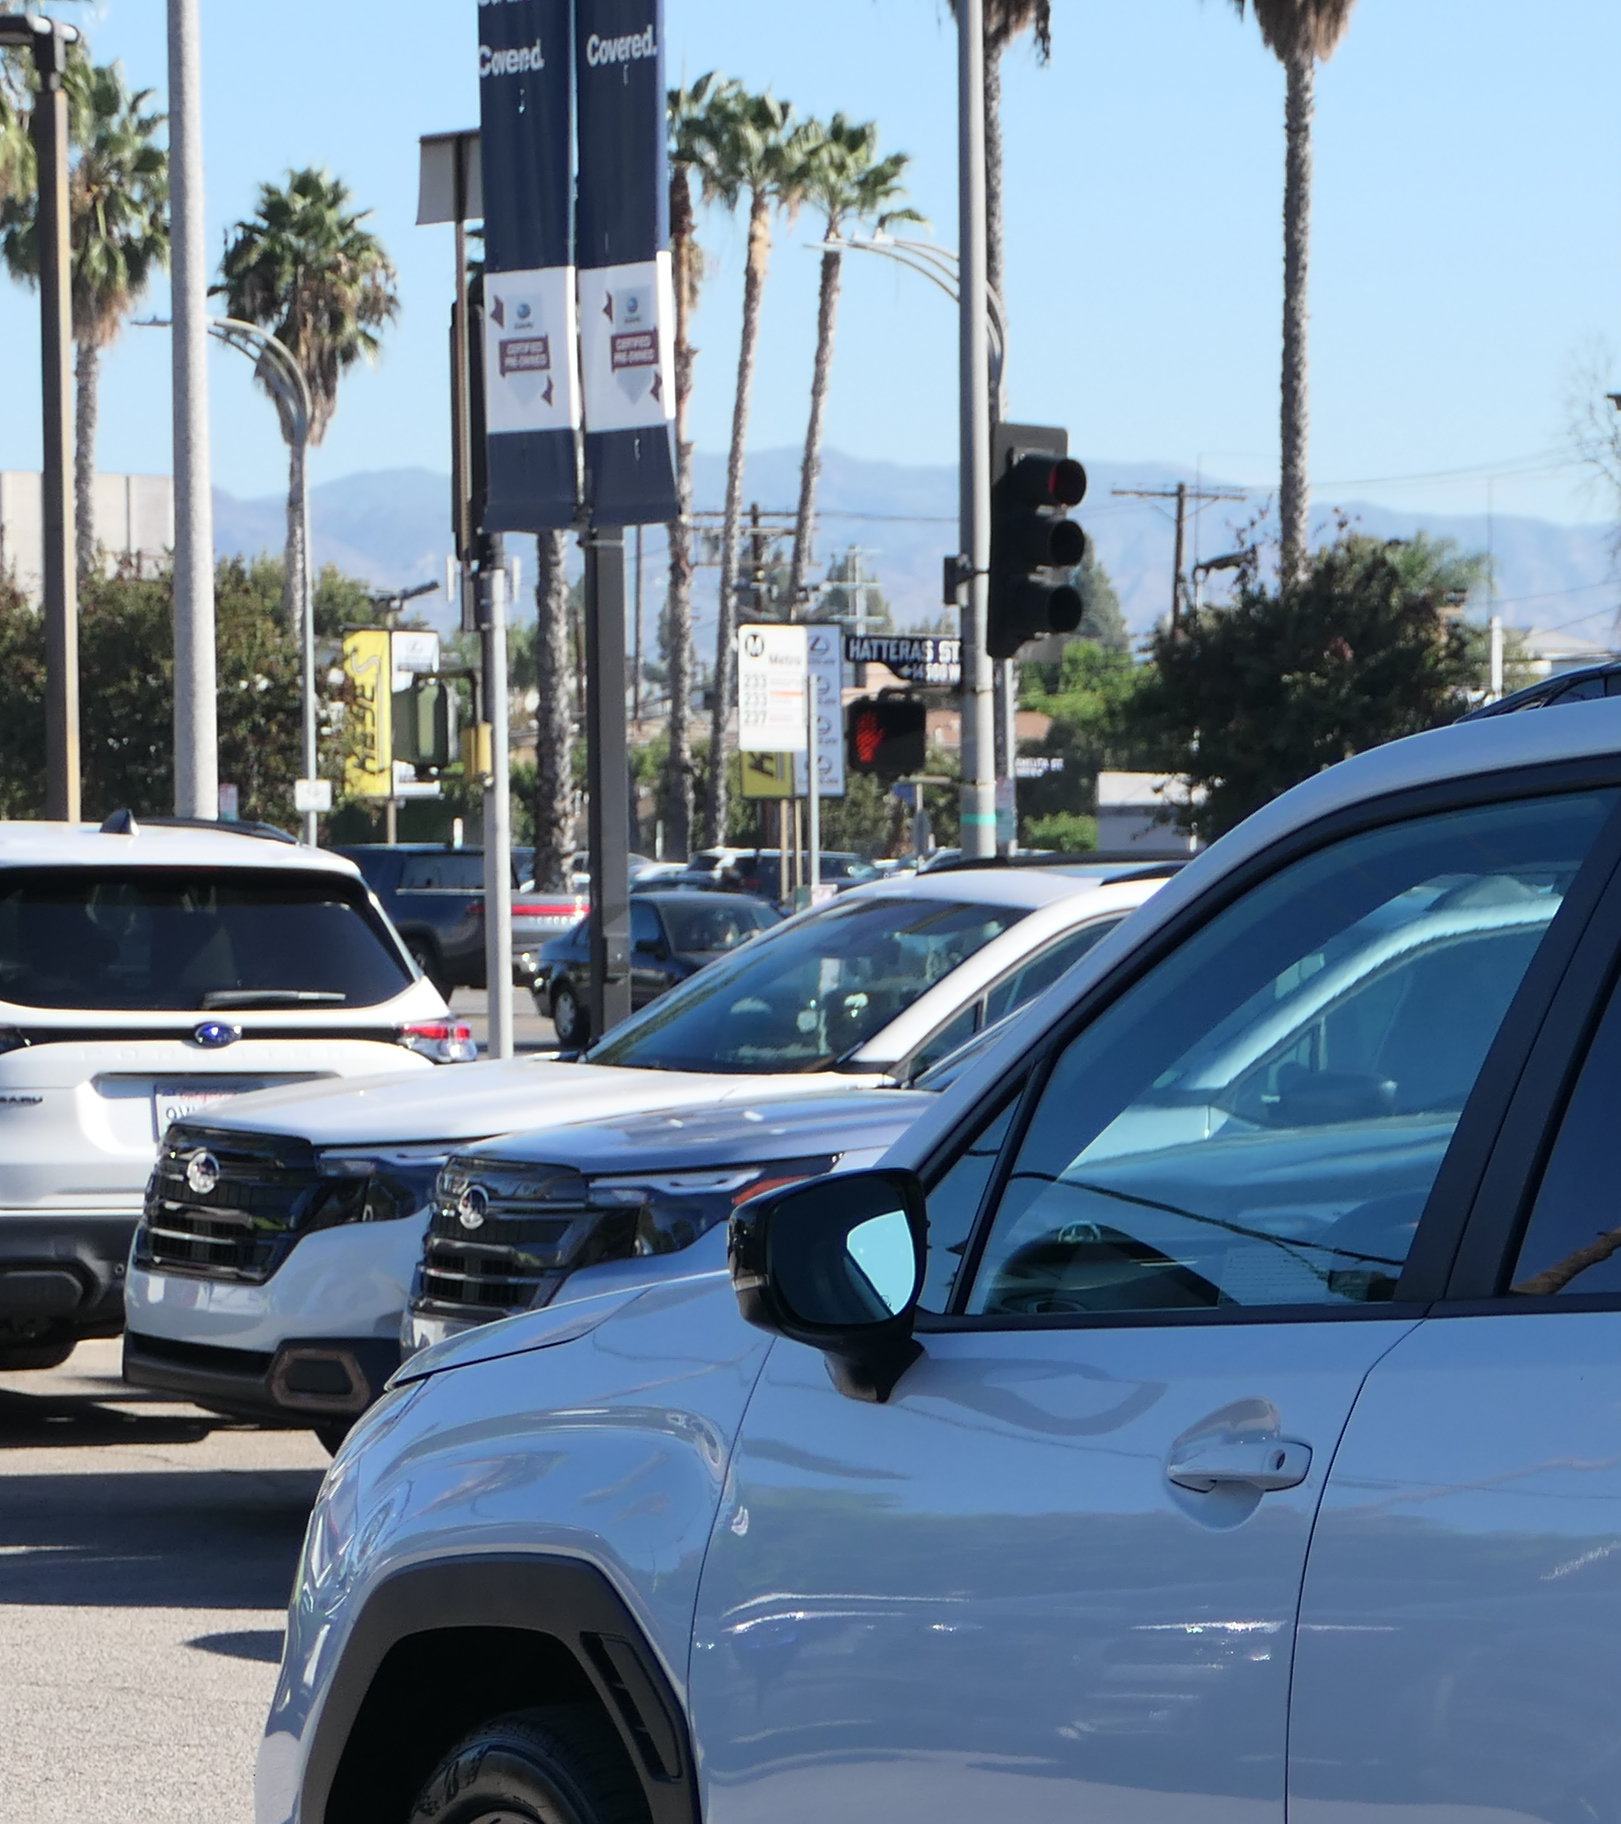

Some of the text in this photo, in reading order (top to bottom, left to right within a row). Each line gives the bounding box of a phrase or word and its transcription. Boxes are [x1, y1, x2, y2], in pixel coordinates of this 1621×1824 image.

[586, 23, 658, 67] Covered.
[848, 638, 961, 664] HATTERAS ST
[768, 654, 802, 667] Metro
[744, 674, 768, 688] 233
[744, 692, 768, 707] 233
[744, 711, 768, 726] 237
